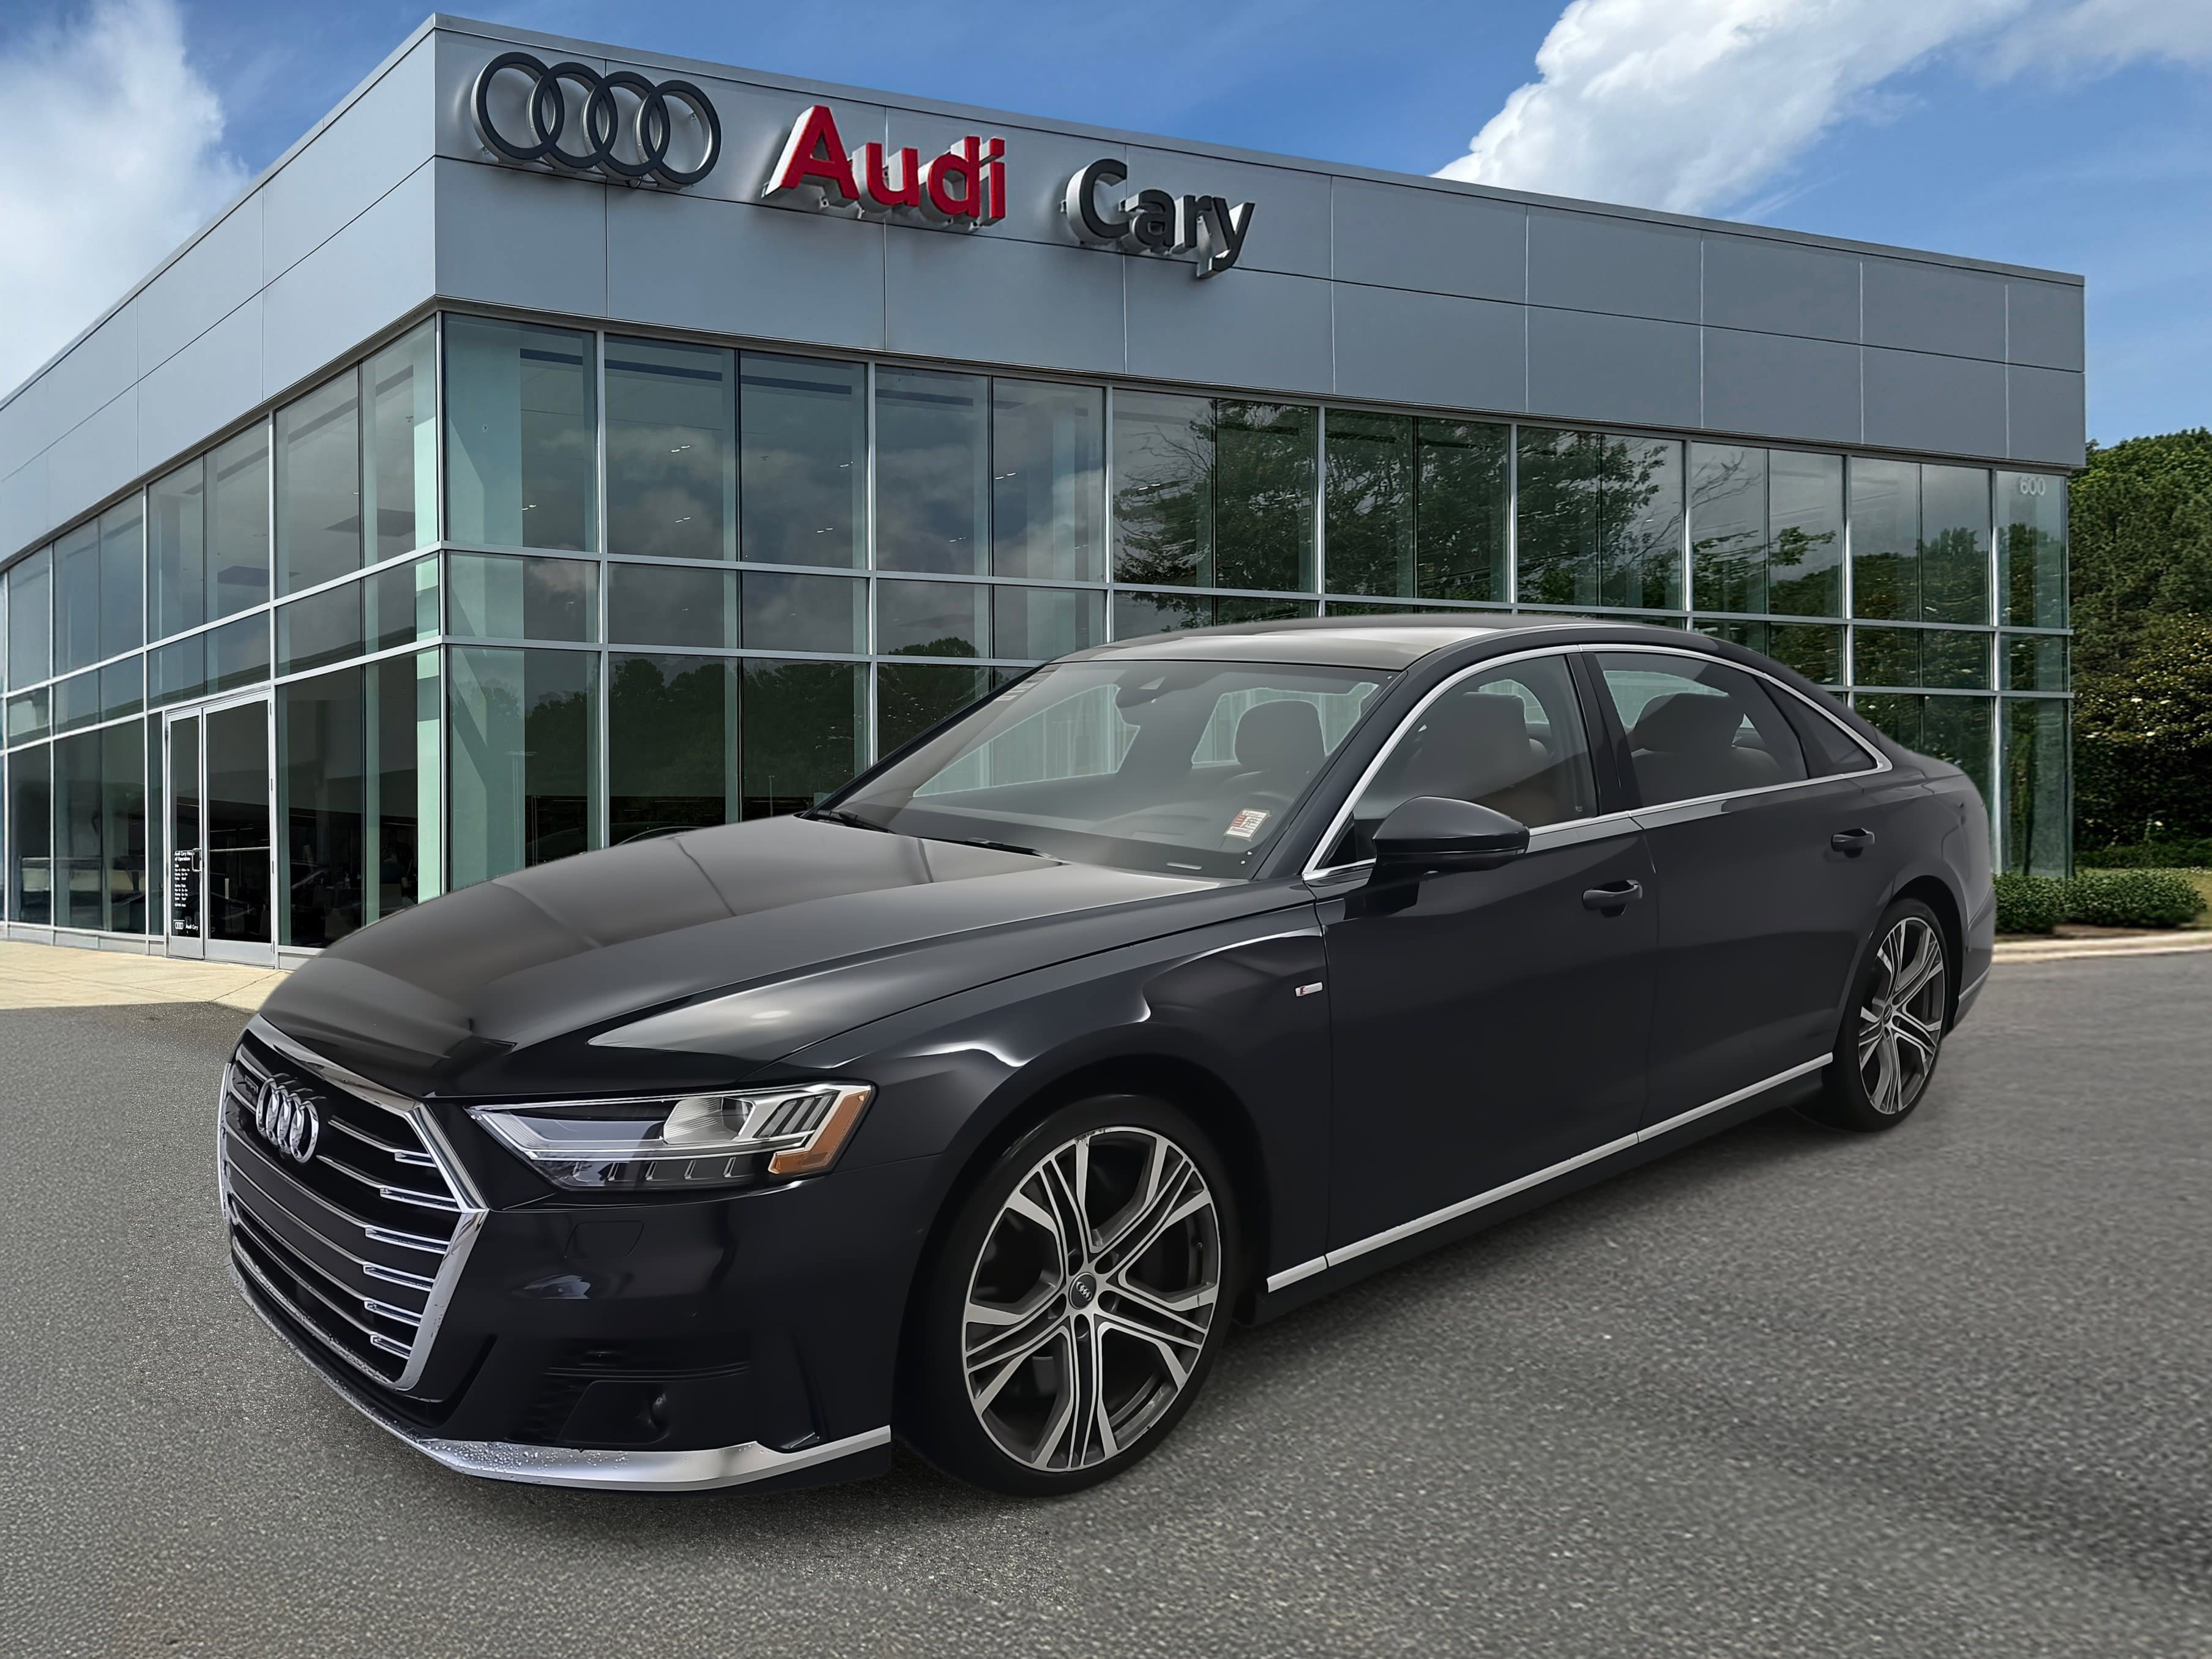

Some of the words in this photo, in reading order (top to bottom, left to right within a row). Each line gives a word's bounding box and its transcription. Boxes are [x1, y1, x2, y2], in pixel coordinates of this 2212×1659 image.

[769, 105, 1006, 224] Audi
[1069, 158, 1255, 275] Cary
[2020, 477, 2046, 496] 600
